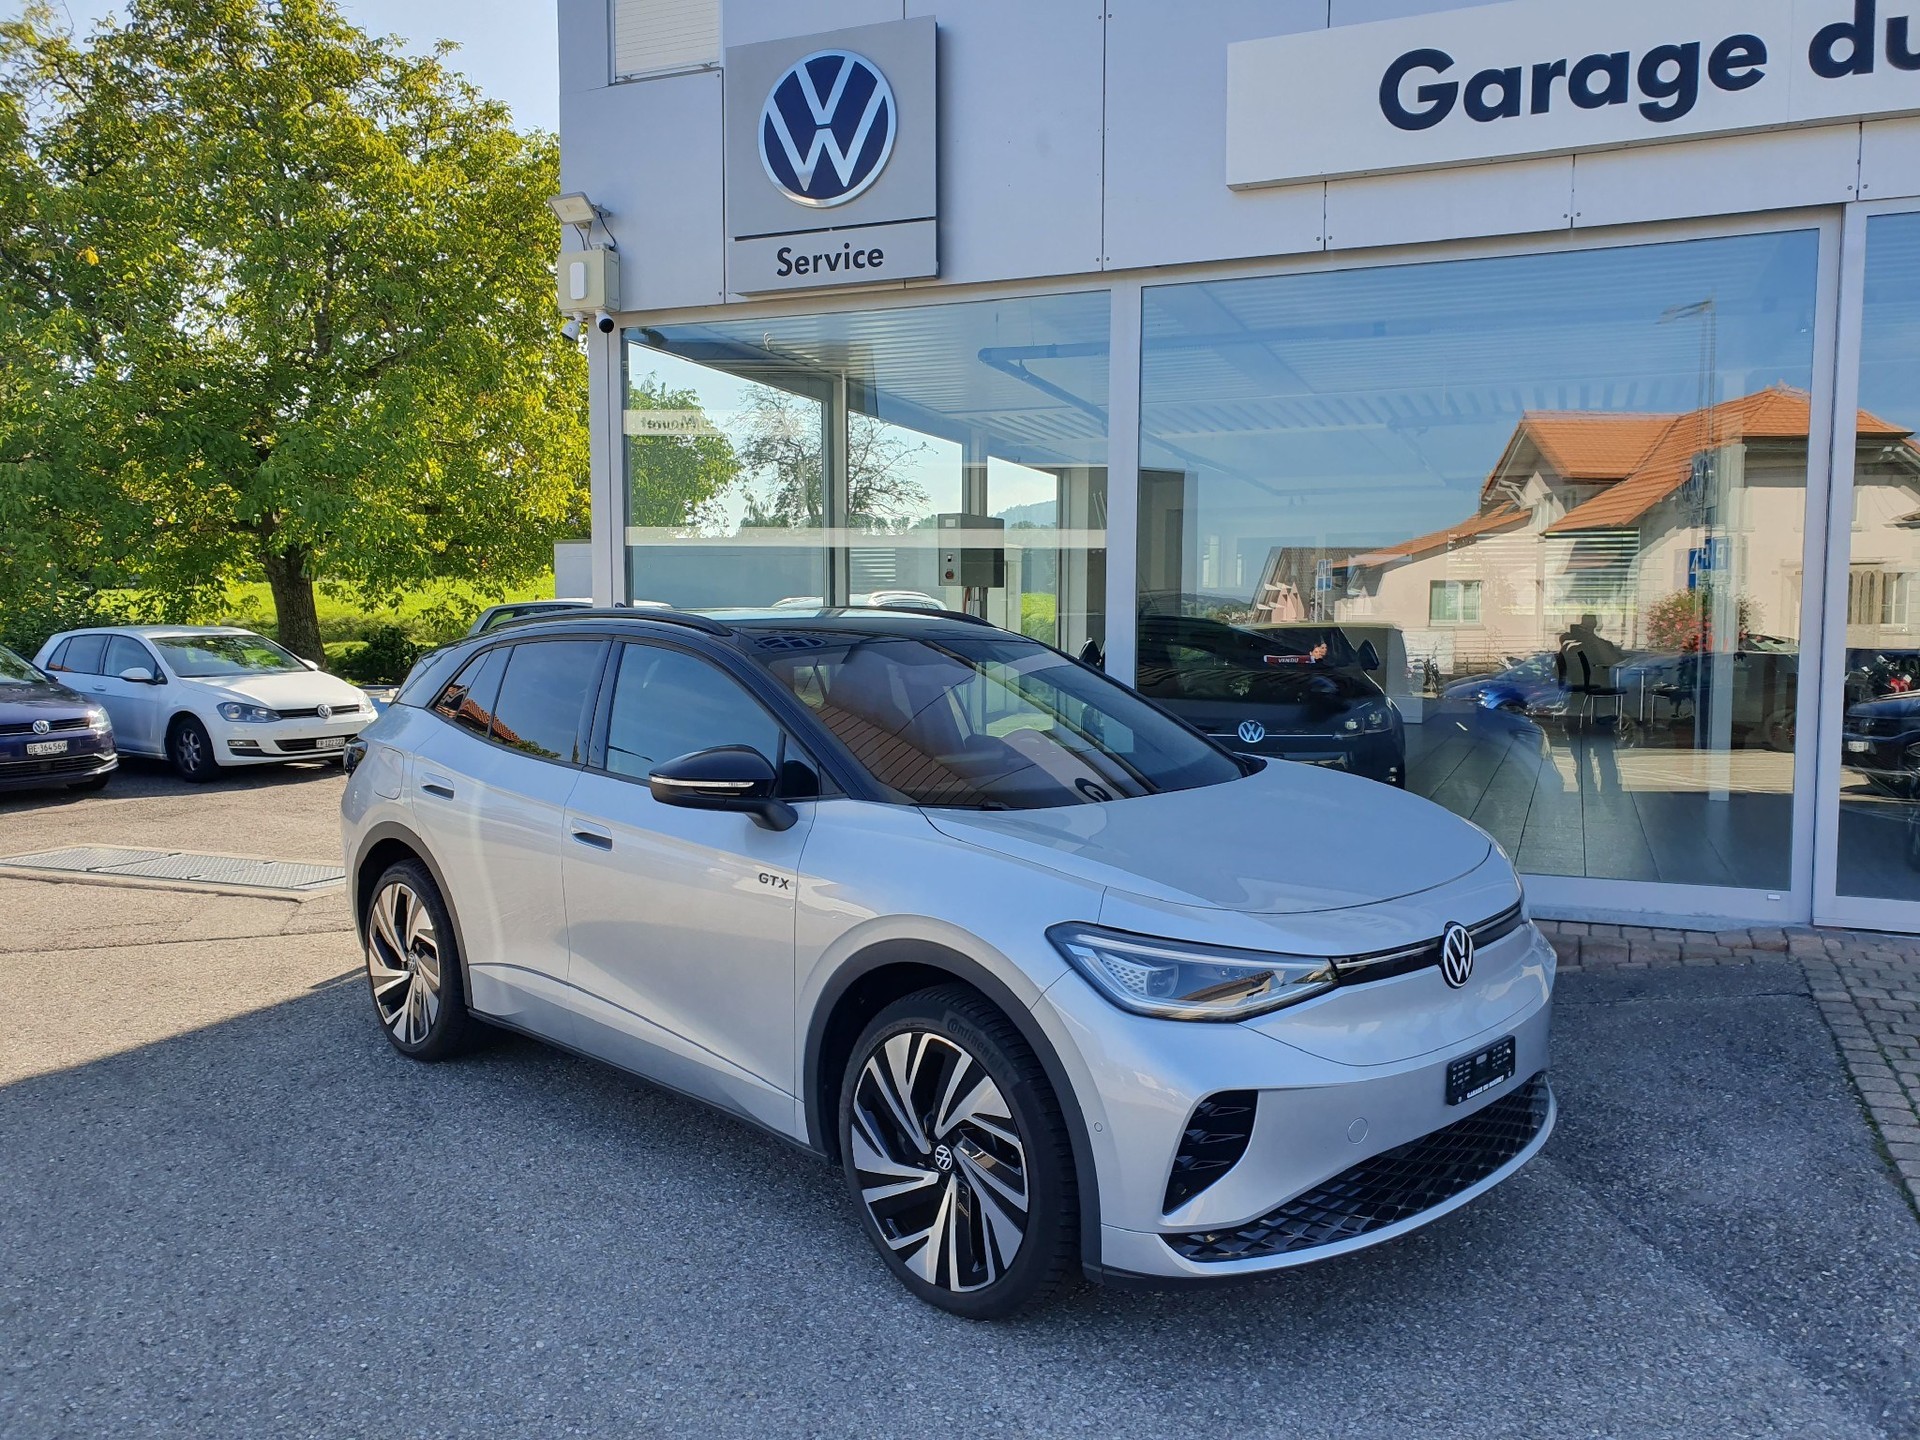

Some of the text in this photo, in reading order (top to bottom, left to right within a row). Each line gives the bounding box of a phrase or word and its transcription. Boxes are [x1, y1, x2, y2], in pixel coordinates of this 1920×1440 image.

[1379, 0, 1920, 131] Garage du
[758, 49, 897, 209] VW
[776, 242, 884, 277] Service
[758, 872, 790, 890] GTX
